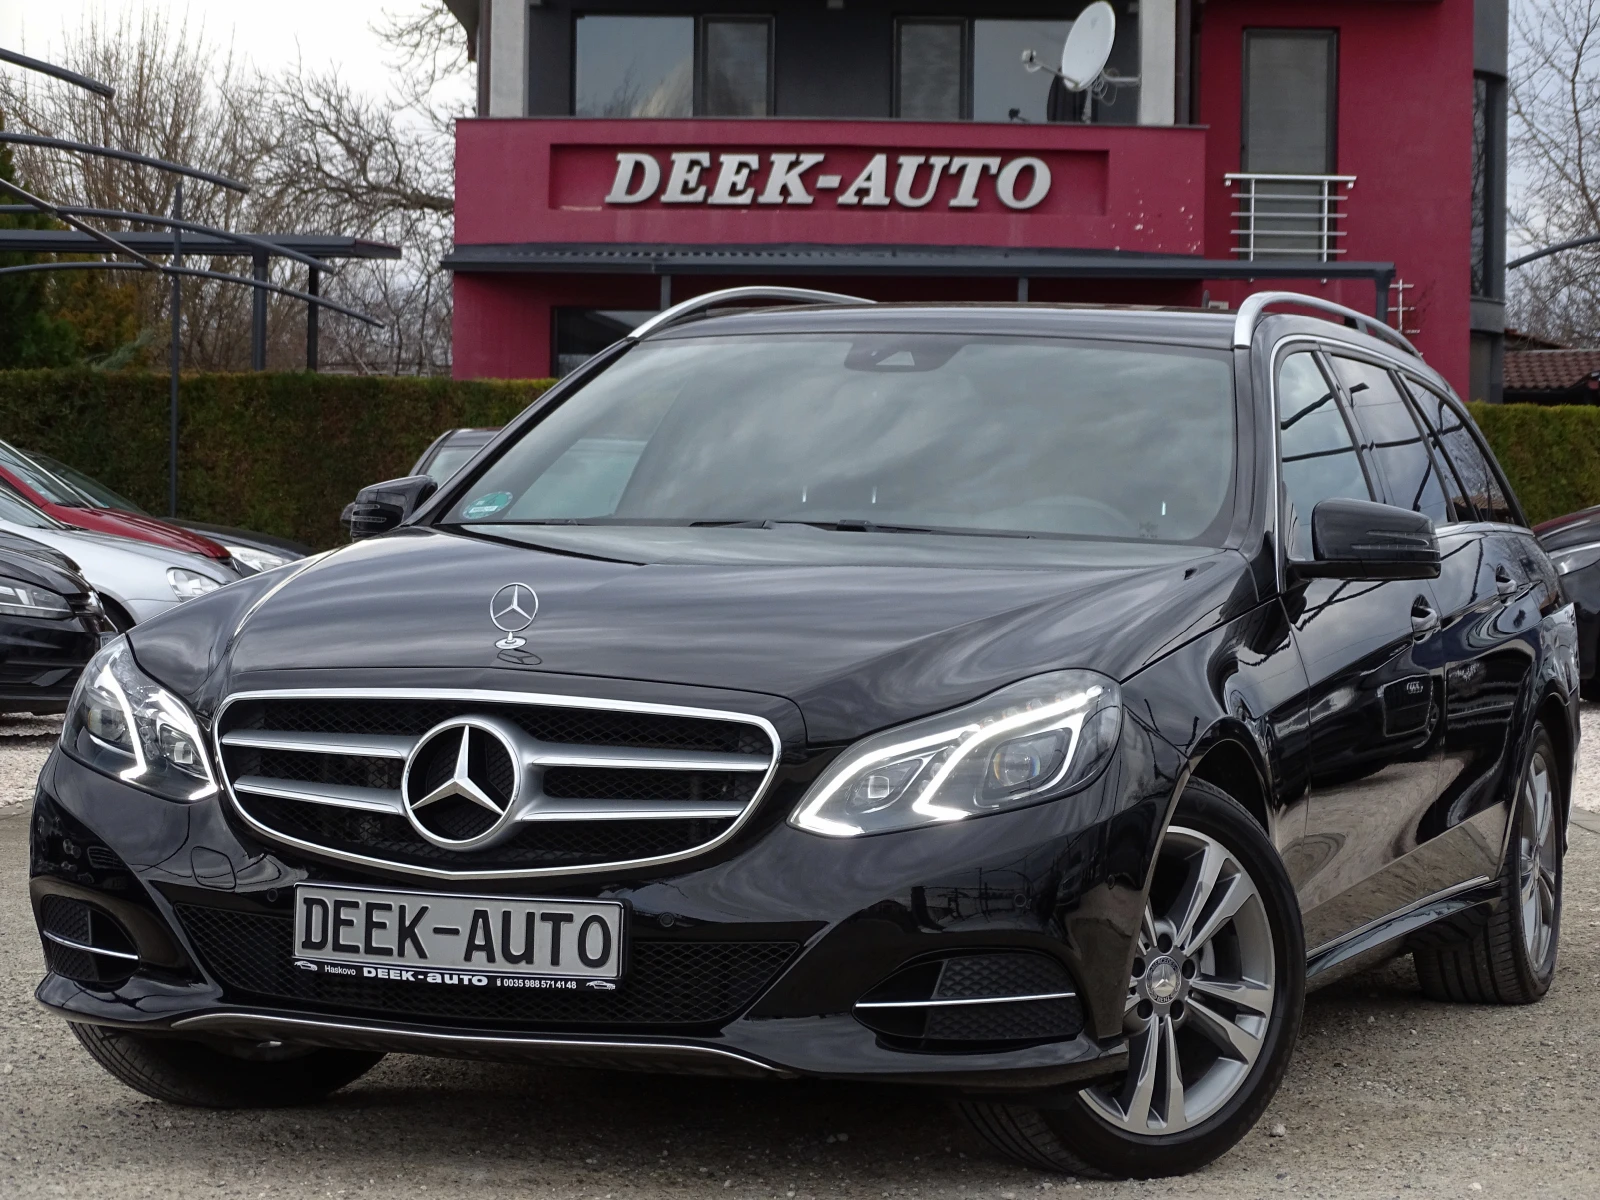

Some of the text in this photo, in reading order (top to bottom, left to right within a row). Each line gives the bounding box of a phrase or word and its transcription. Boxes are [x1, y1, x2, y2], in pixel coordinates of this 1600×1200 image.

[603, 152, 1052, 210] DEEK-AUTO
[301, 896, 612, 969] DEEK-AUTO
[324, 964, 356, 976] Haskovo
[503, 978, 524, 987] 0035
[524, 979, 540, 988] 988
